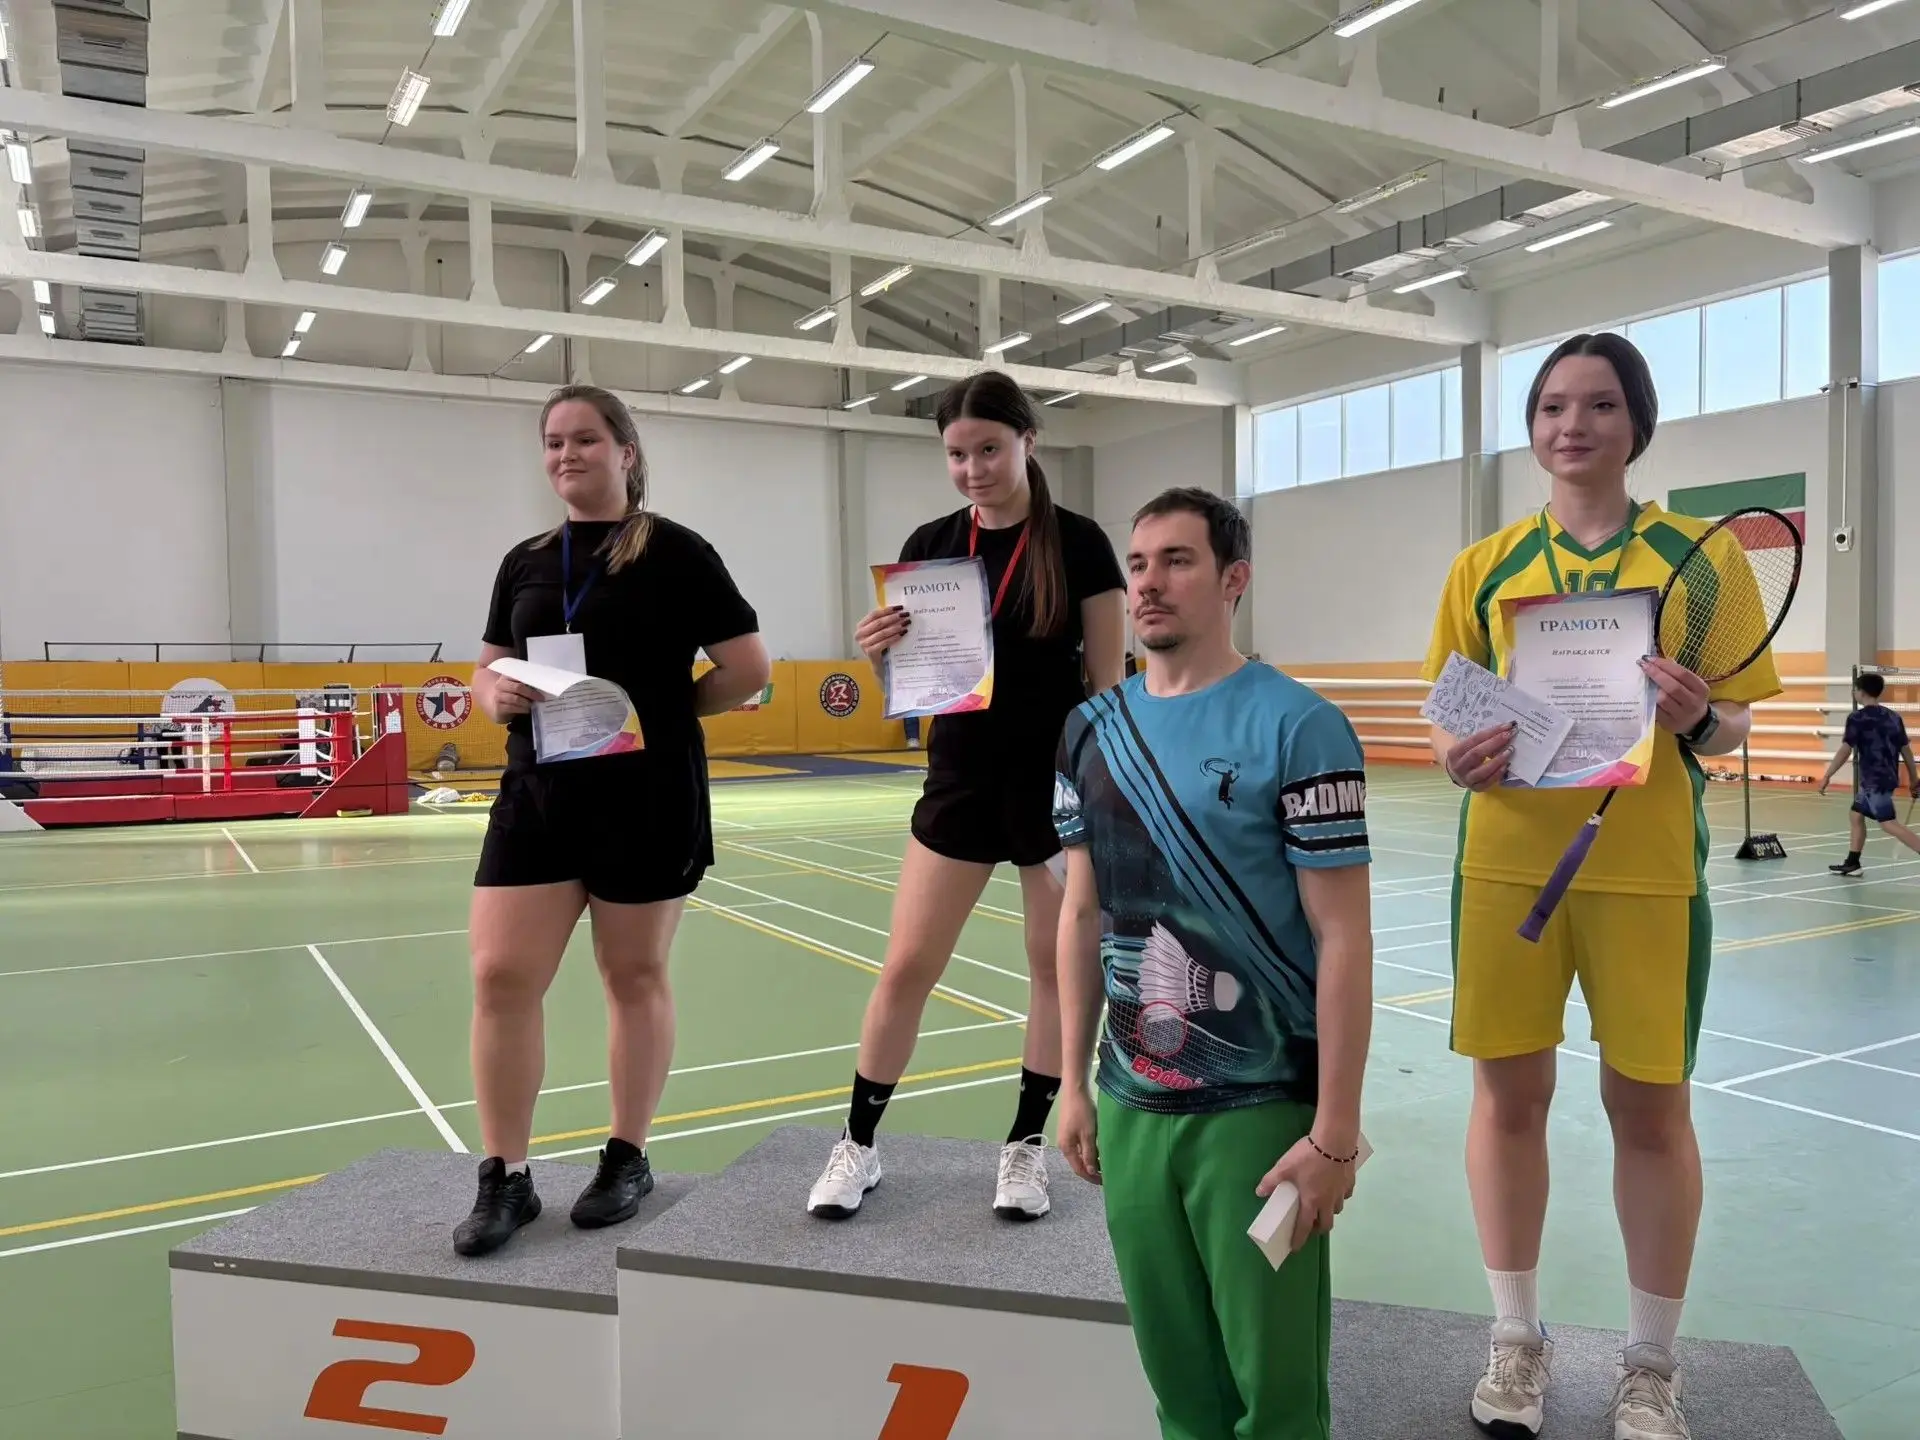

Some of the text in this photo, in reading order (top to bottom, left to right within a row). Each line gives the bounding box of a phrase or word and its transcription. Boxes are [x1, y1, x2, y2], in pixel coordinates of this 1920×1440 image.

[903, 581, 961, 596] ГРАМОТА
[1540, 617, 1620, 632] ГРАМОТА
[425, 717, 463, 729] САМБО
[303, 1318, 476, 1436] 2
[877, 1362, 970, 1440] 1
